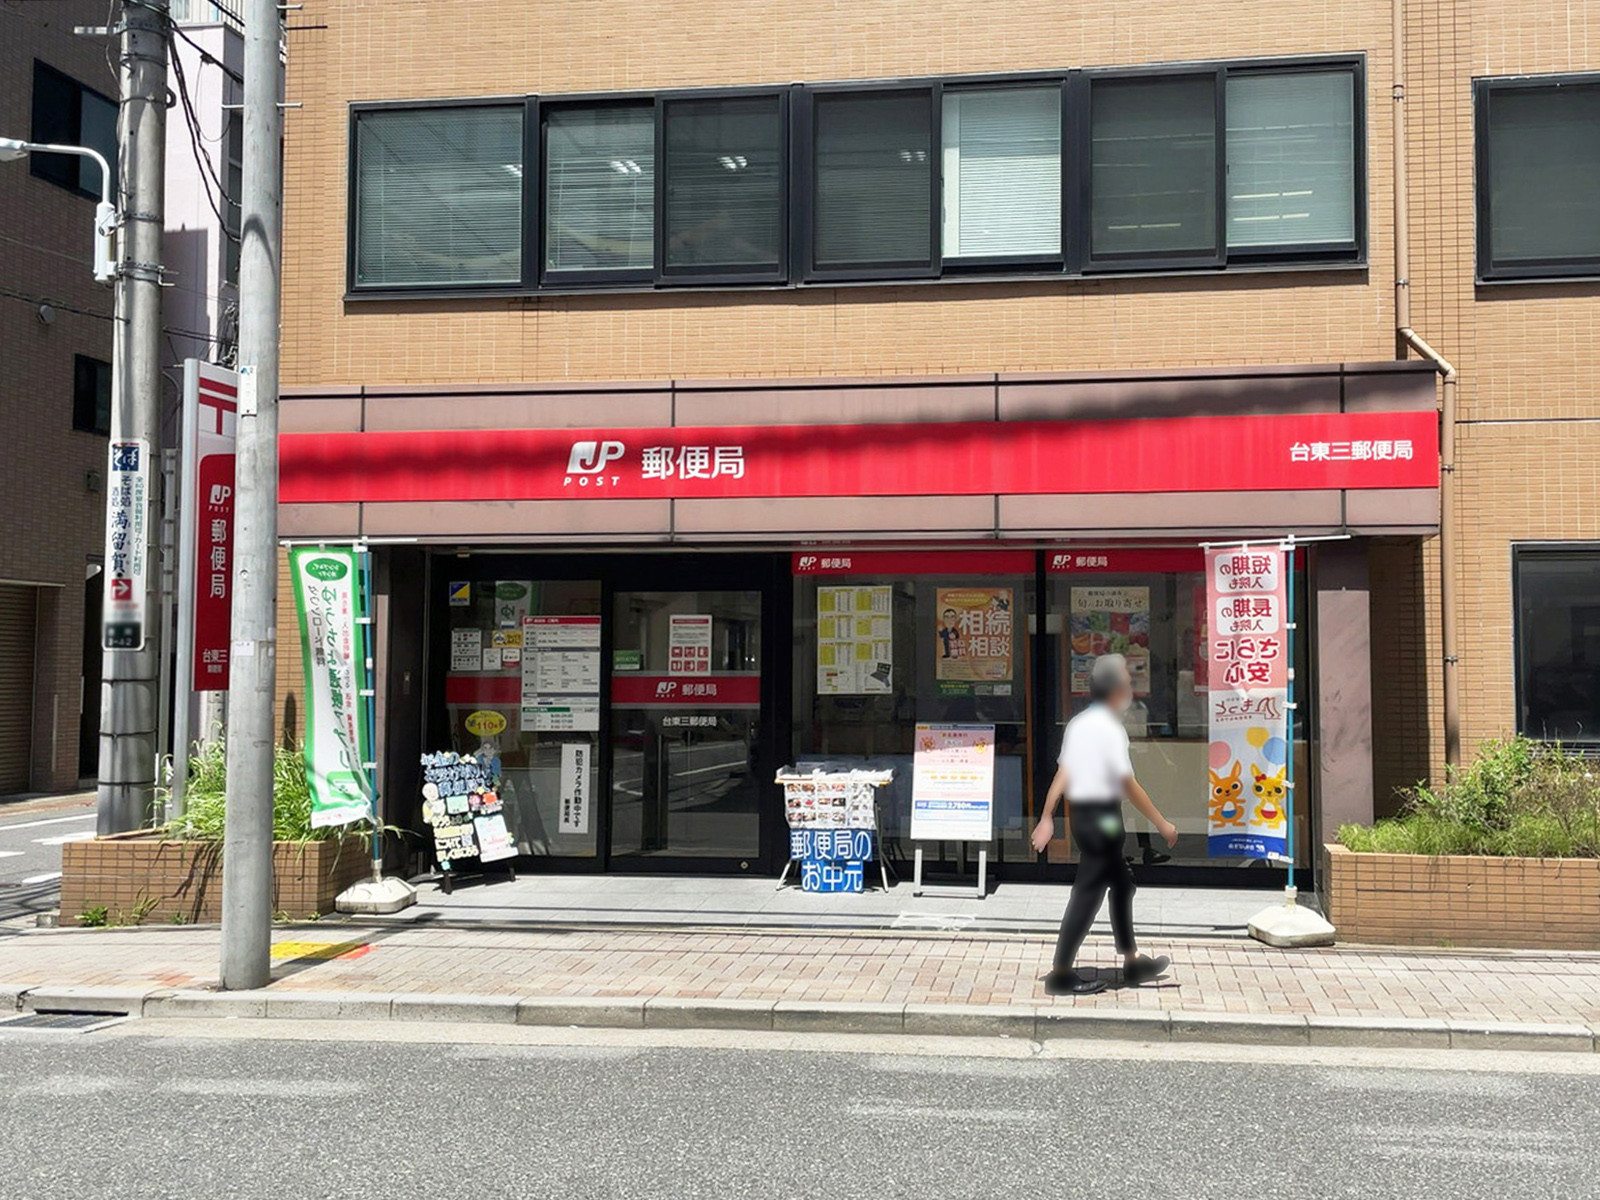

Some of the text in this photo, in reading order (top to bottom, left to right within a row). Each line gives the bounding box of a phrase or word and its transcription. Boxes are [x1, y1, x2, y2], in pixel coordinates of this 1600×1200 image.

[113, 448, 138, 467] そば
[1289, 439, 1414, 462] 台東三郵便局
[641, 445, 745, 480] 郵便局
[563, 476, 620, 487] POST
[210, 519, 227, 599] 郵便局
[820, 558, 852, 569] 郵便局
[1075, 556, 1108, 567] 郵便局
[959, 610, 1011, 636] 相続
[202, 648, 228, 663] 台東三
[968, 636, 1010, 657] 相談
[681, 684, 717, 697] 郵便局
[661, 716, 718, 727] 台東三郵便局
[573, 749, 584, 828] 防犯カメラ作動中です
[791, 829, 872, 861] 郵便局の
[802, 860, 863, 892] お中元
